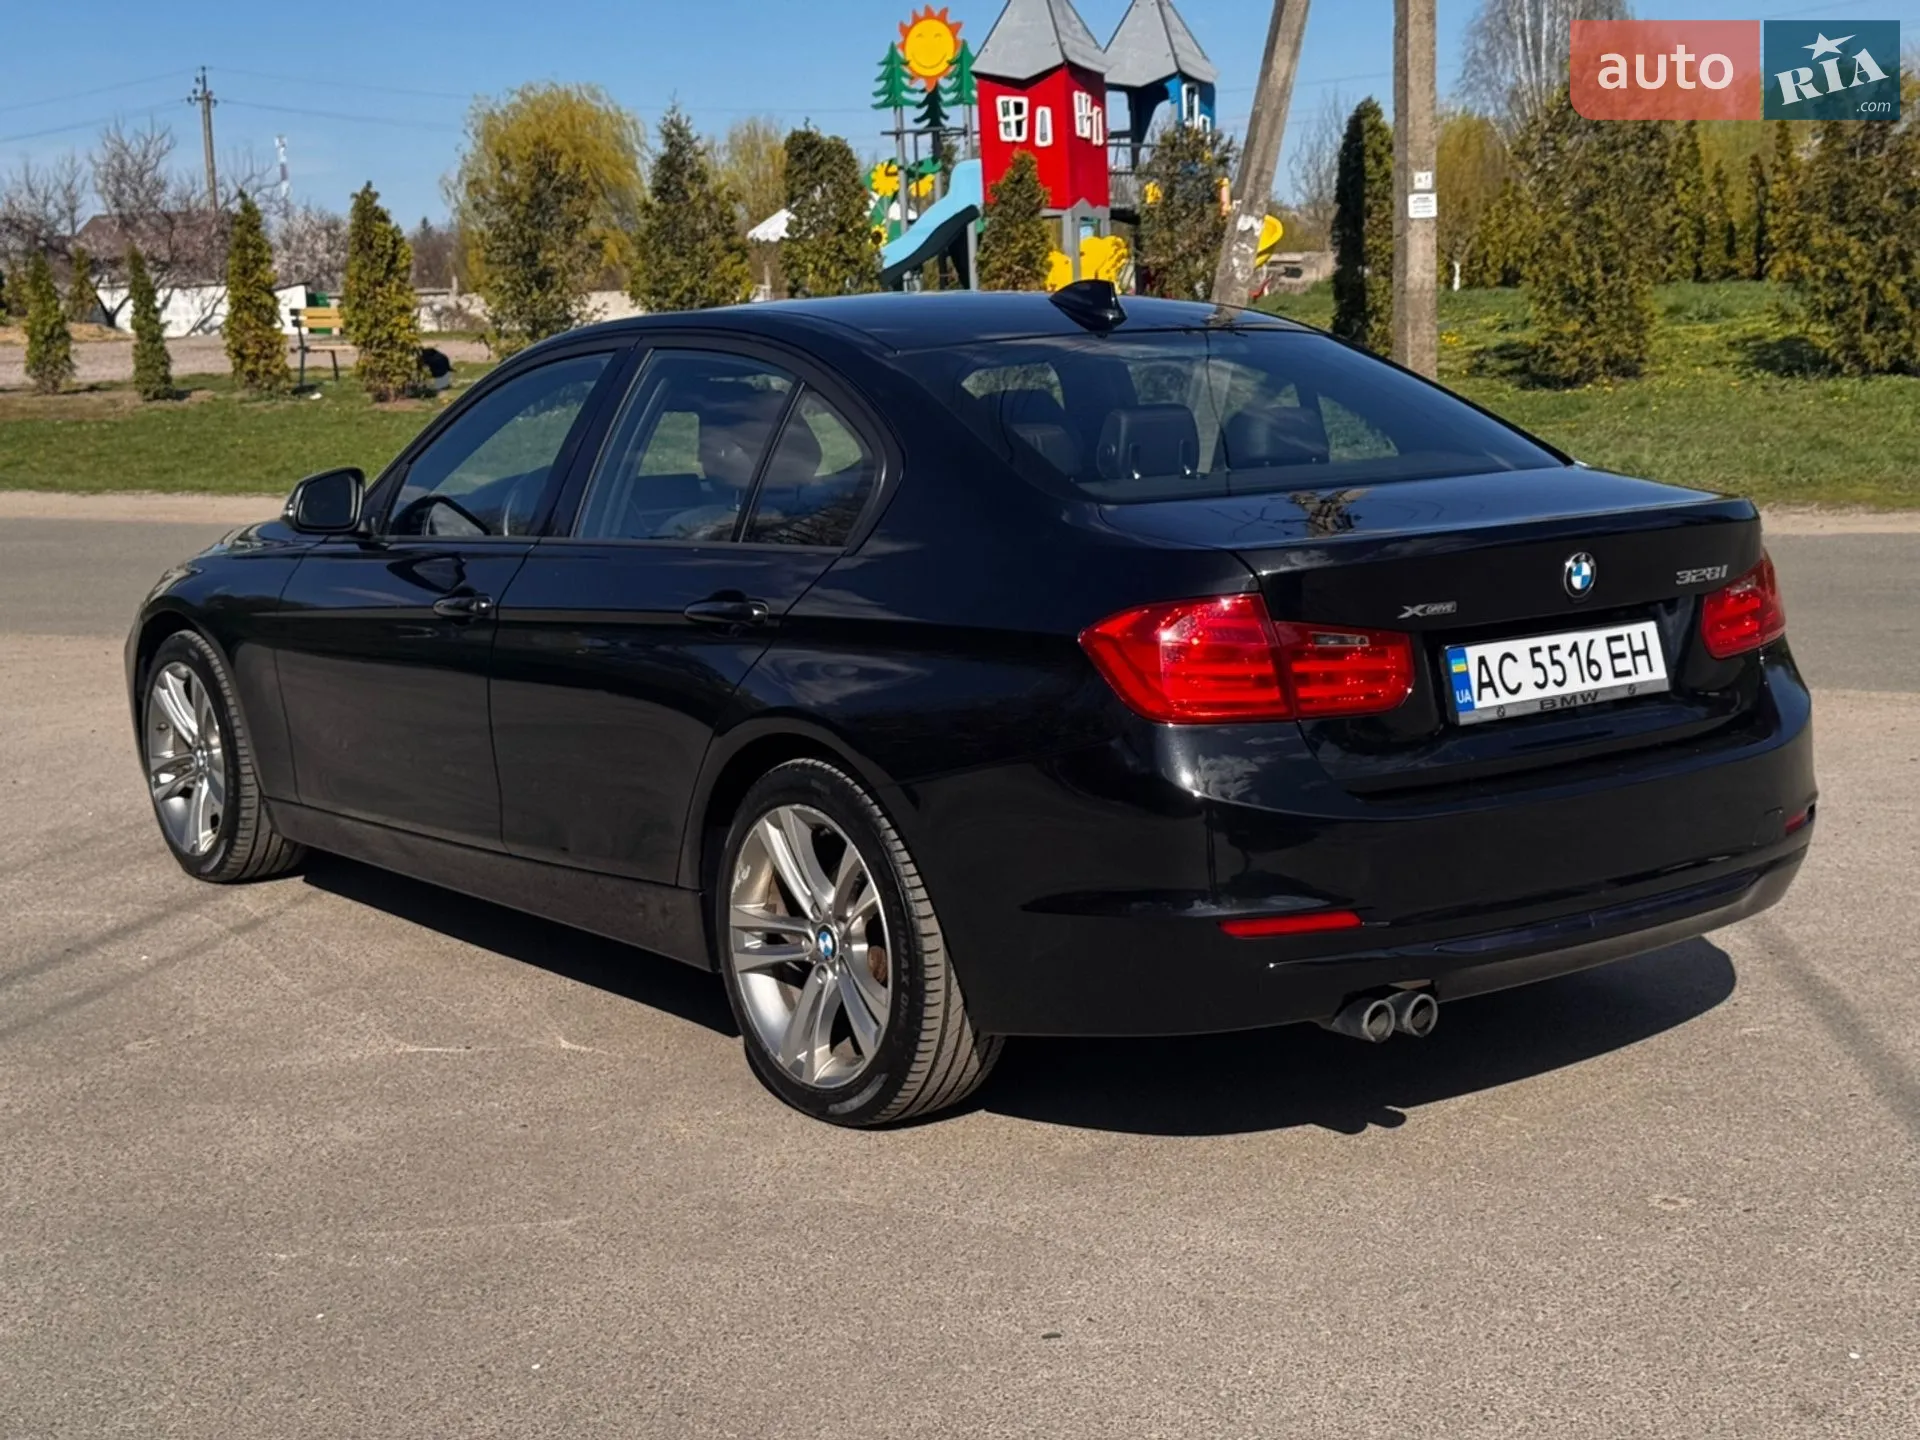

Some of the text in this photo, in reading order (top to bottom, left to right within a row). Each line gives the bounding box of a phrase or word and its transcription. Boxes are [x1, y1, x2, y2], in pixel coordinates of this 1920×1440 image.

[1477, 631, 1653, 702] AC 5516 EH
[1455, 688, 1472, 704] UA
[1539, 691, 1599, 711] BMW
